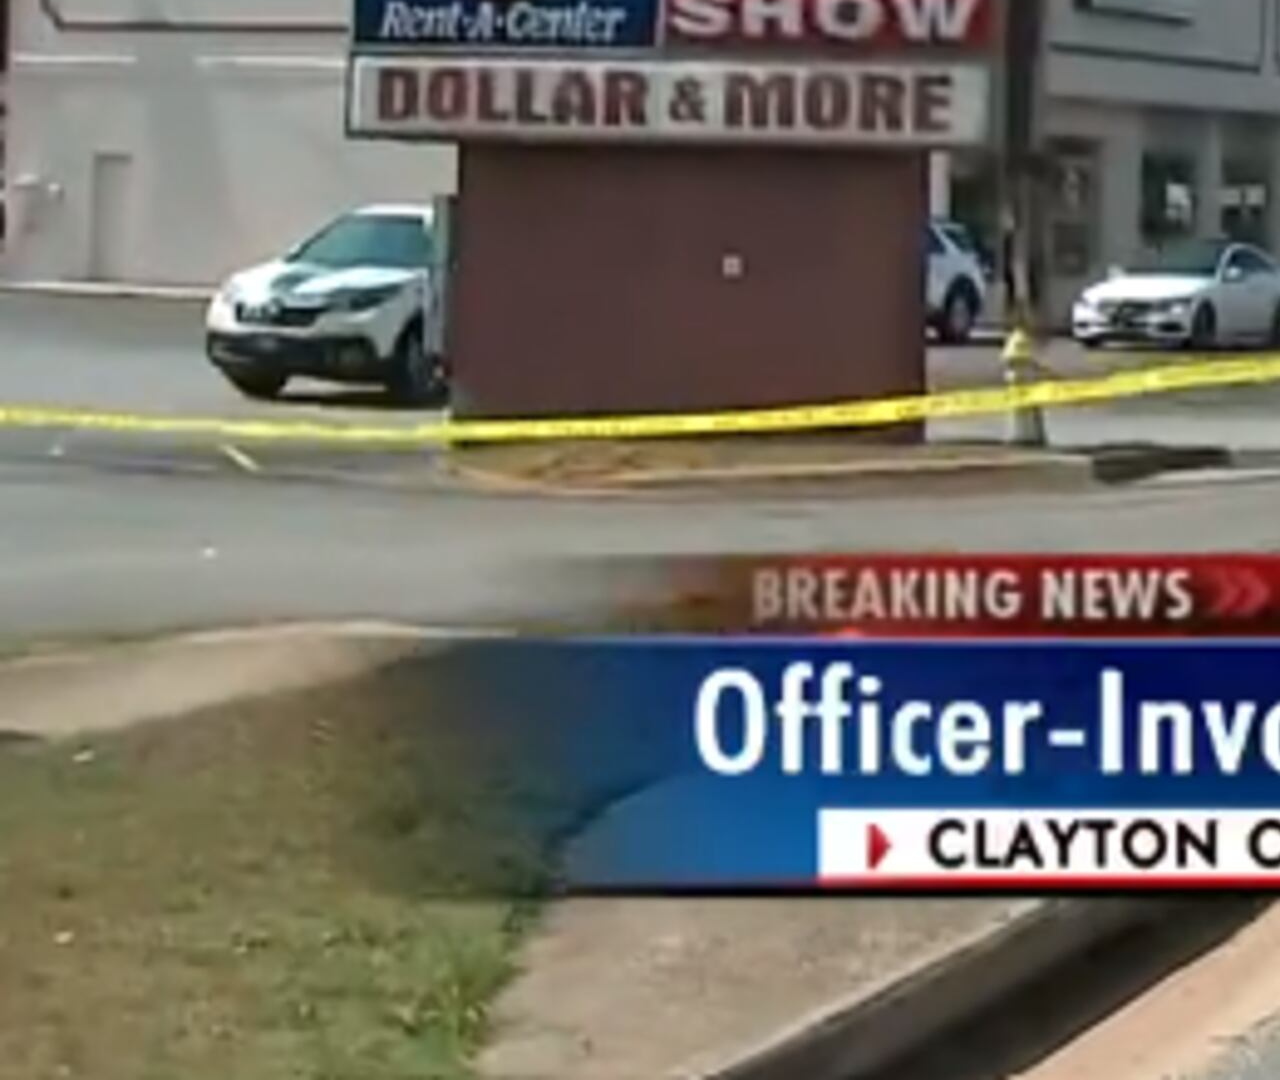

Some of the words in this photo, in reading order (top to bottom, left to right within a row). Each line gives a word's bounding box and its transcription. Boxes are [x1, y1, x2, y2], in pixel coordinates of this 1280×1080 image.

[378, 68, 649, 128] DOLLAR
[670, 79, 708, 125] &
[723, 73, 951, 133] MORE
